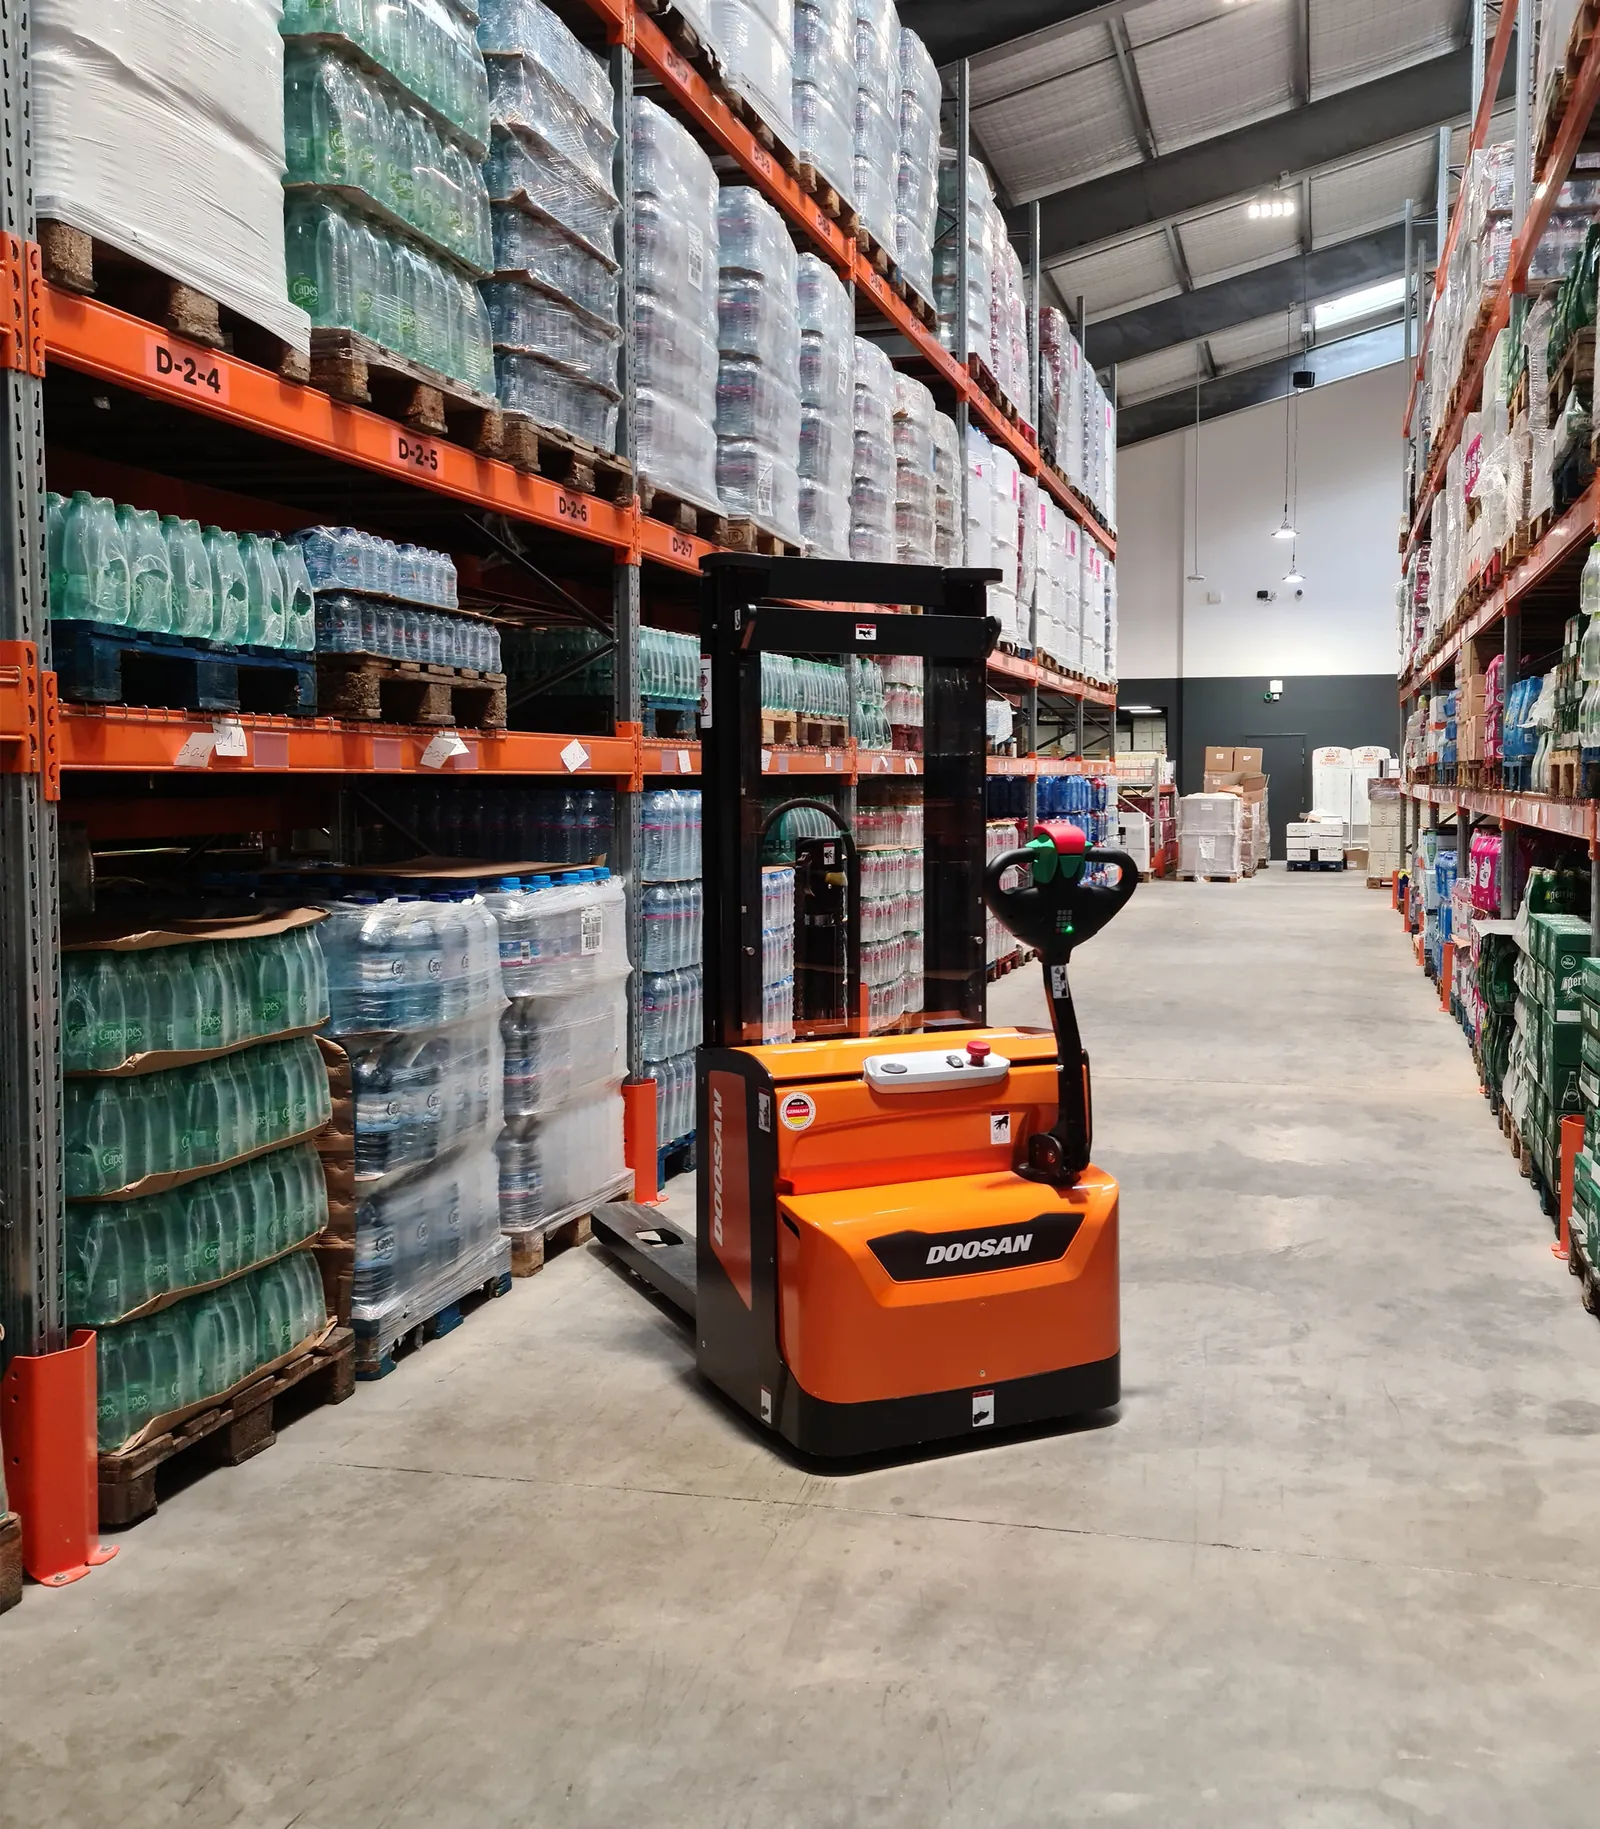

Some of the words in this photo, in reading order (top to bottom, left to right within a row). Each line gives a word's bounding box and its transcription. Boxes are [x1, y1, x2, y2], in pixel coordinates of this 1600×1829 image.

[292, 281, 319, 298] Capes
[156, 345, 222, 394] D-2-4
[398, 437, 438, 471] D-2-5
[559, 496, 587, 522] D-2-6
[672, 536, 693, 558] D-2-7
[103, 1153, 124, 1169] Cape
[713, 1087, 723, 1247] DOOSAN
[925, 1233, 1034, 1265] DOOSAN
